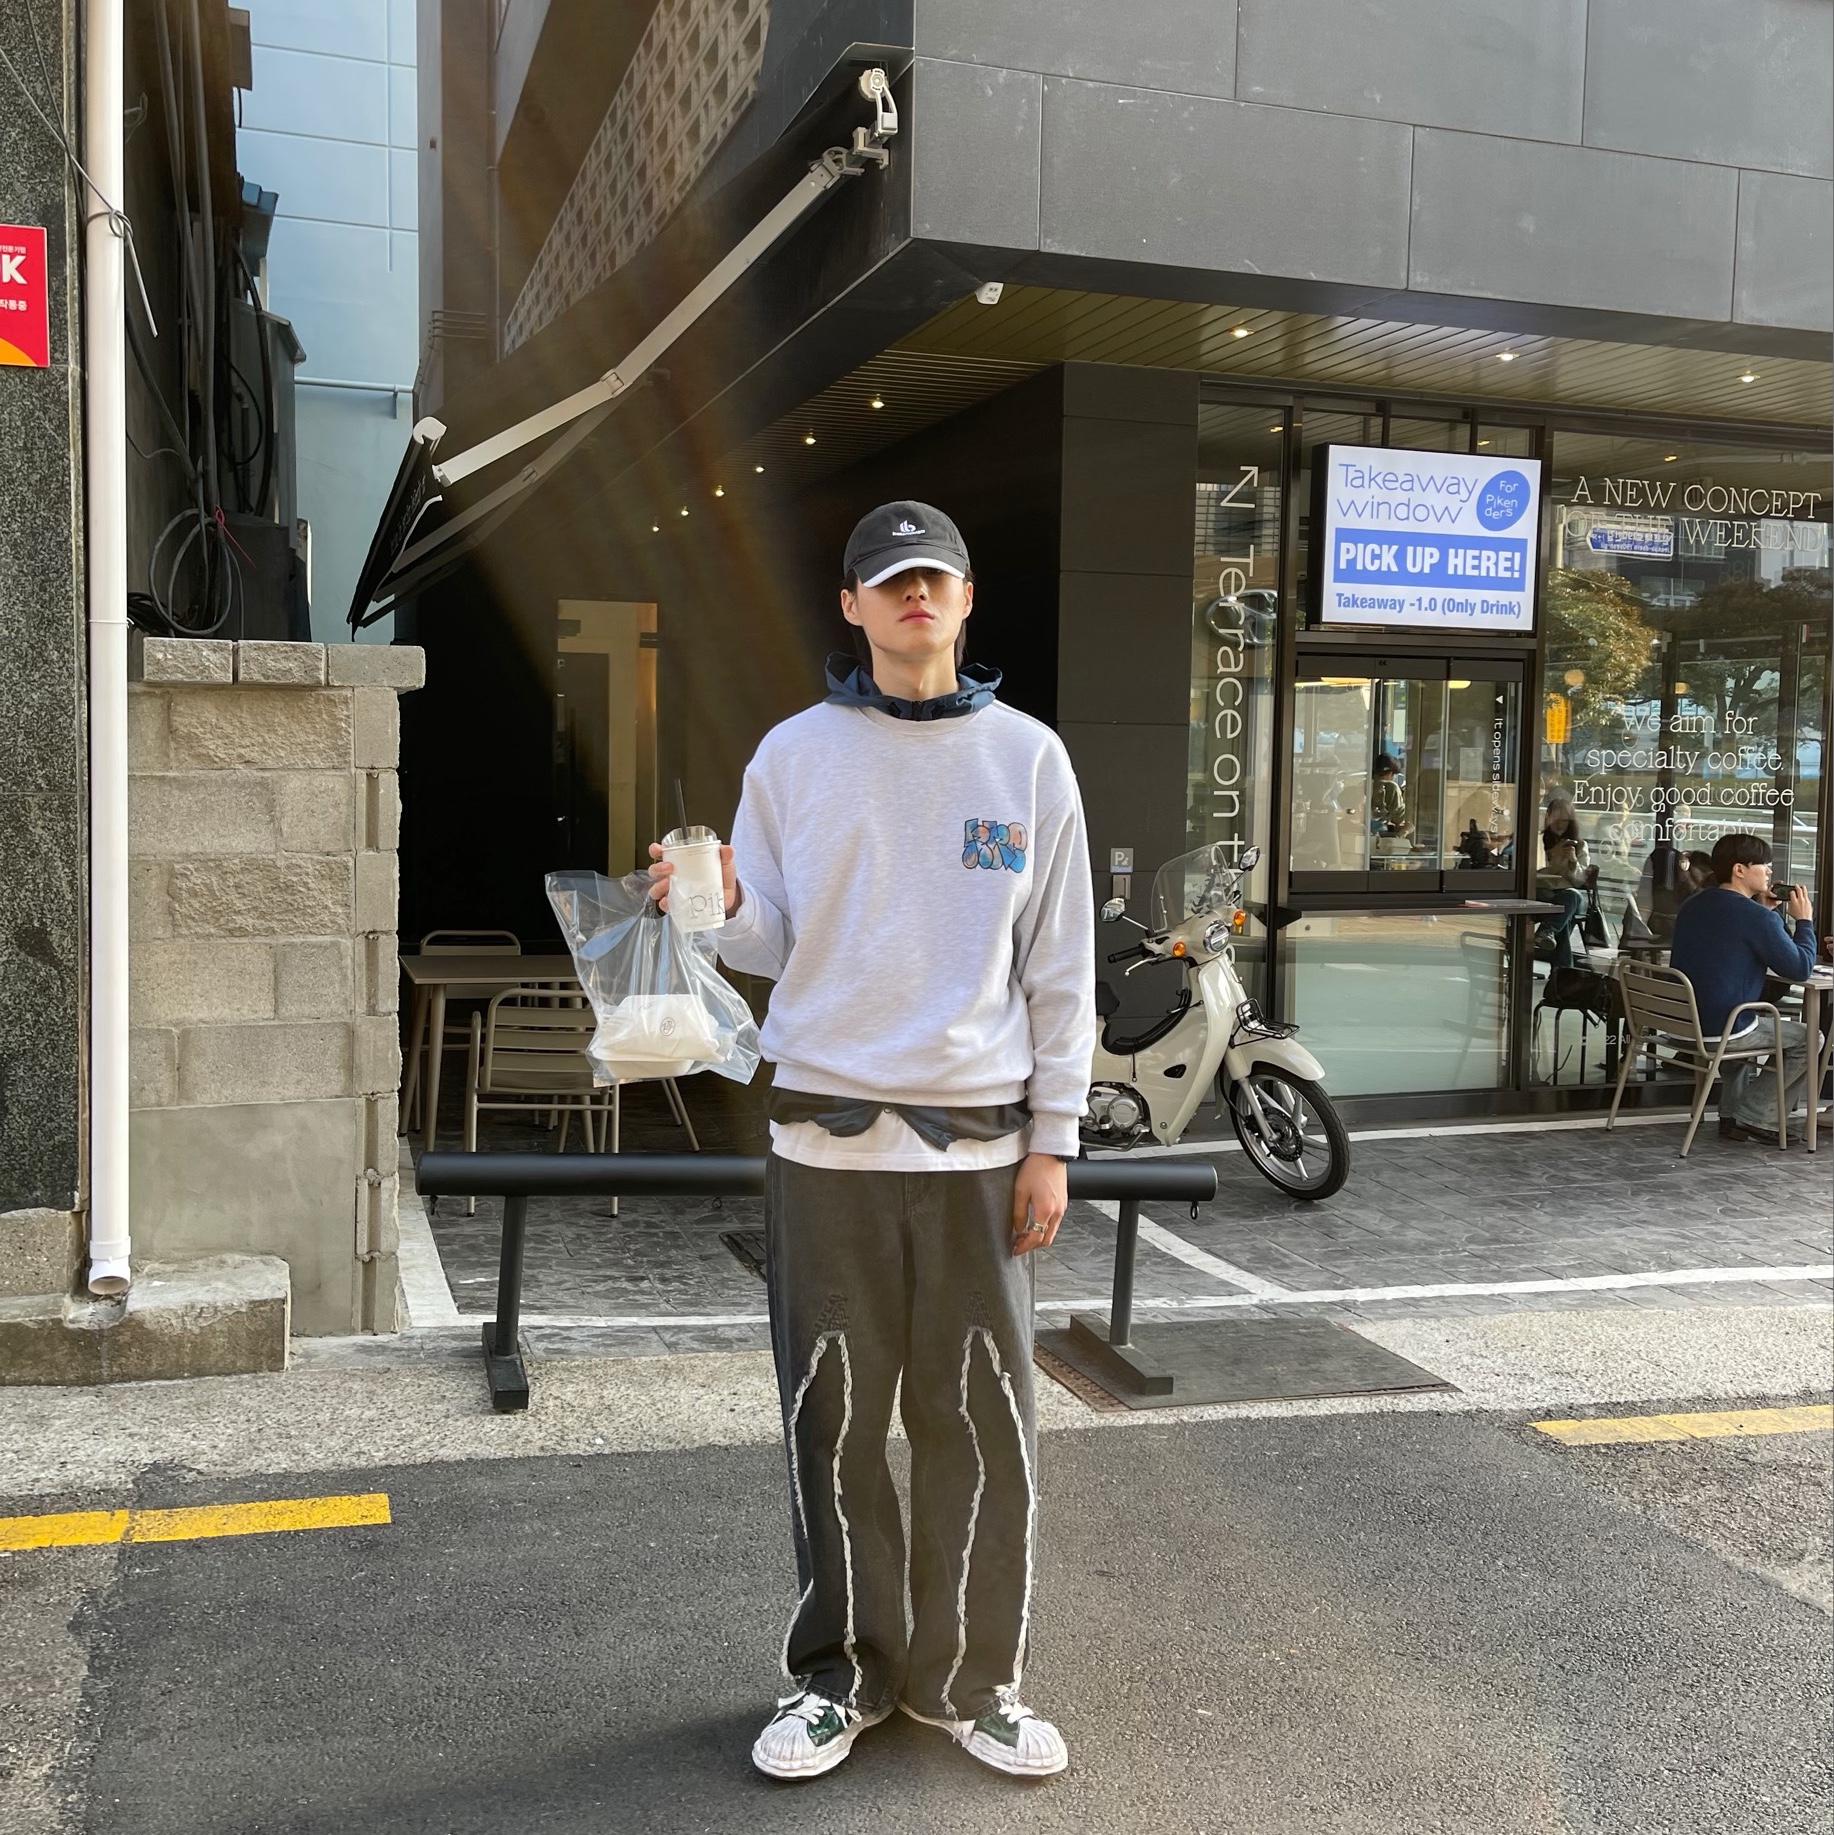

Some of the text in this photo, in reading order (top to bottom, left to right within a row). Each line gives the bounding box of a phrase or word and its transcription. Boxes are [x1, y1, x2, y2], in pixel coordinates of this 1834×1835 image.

[1338, 463, 1479, 503] Takeaway
[1500, 481, 1519, 493] For
[1571, 476, 1822, 518] A NEW CONCEPT
[1336, 495, 1463, 524] window
[1484, 508, 1513, 520] ders
[1486, 494, 1518, 509] Piken
[1682, 517, 1826, 551] WEEKEND
[1339, 541, 1521, 578] PICK UP HERE!
[1336, 592, 1521, 618] Takeaway -1.0 (Only Drink)
[1215, 544, 1255, 739] Terrace
[1669, 711, 1717, 733] aim
[1724, 710, 1758, 735] for
[1488, 718, 1504, 834] It opens sideways
[1587, 745, 1784, 775] specialty coffee.
[1212, 752, 1241, 818] on
[1572, 780, 1642, 812] Enjoy
[1650, 783, 1712, 812] good
[1720, 783, 1795, 807] coffee
